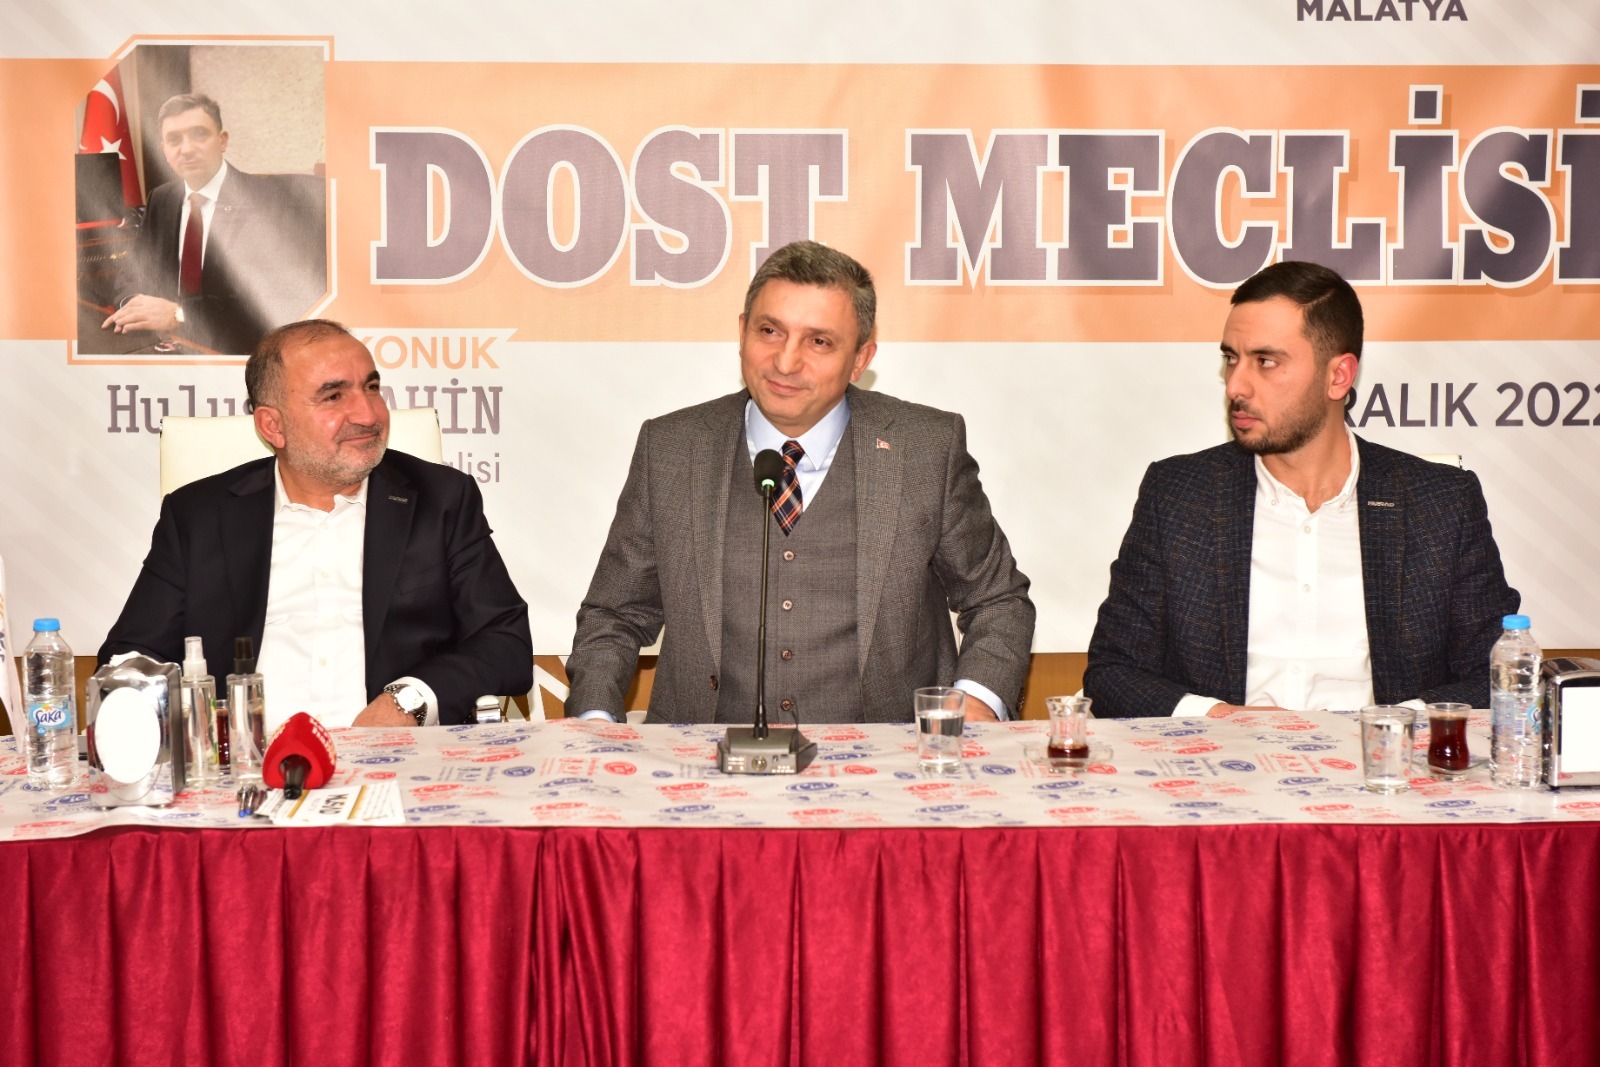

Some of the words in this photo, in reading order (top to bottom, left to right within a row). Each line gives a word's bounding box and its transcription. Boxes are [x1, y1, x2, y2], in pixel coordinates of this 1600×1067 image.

[1296, 0, 1469, 21] MALATYA
[369, 124, 849, 289] DOST
[904, 84, 1600, 290] MECLİSİ
[361, 335, 500, 370] ONUK
[1344, 382, 1479, 428] ALIK
[1495, 381, 1600, 427] 202
